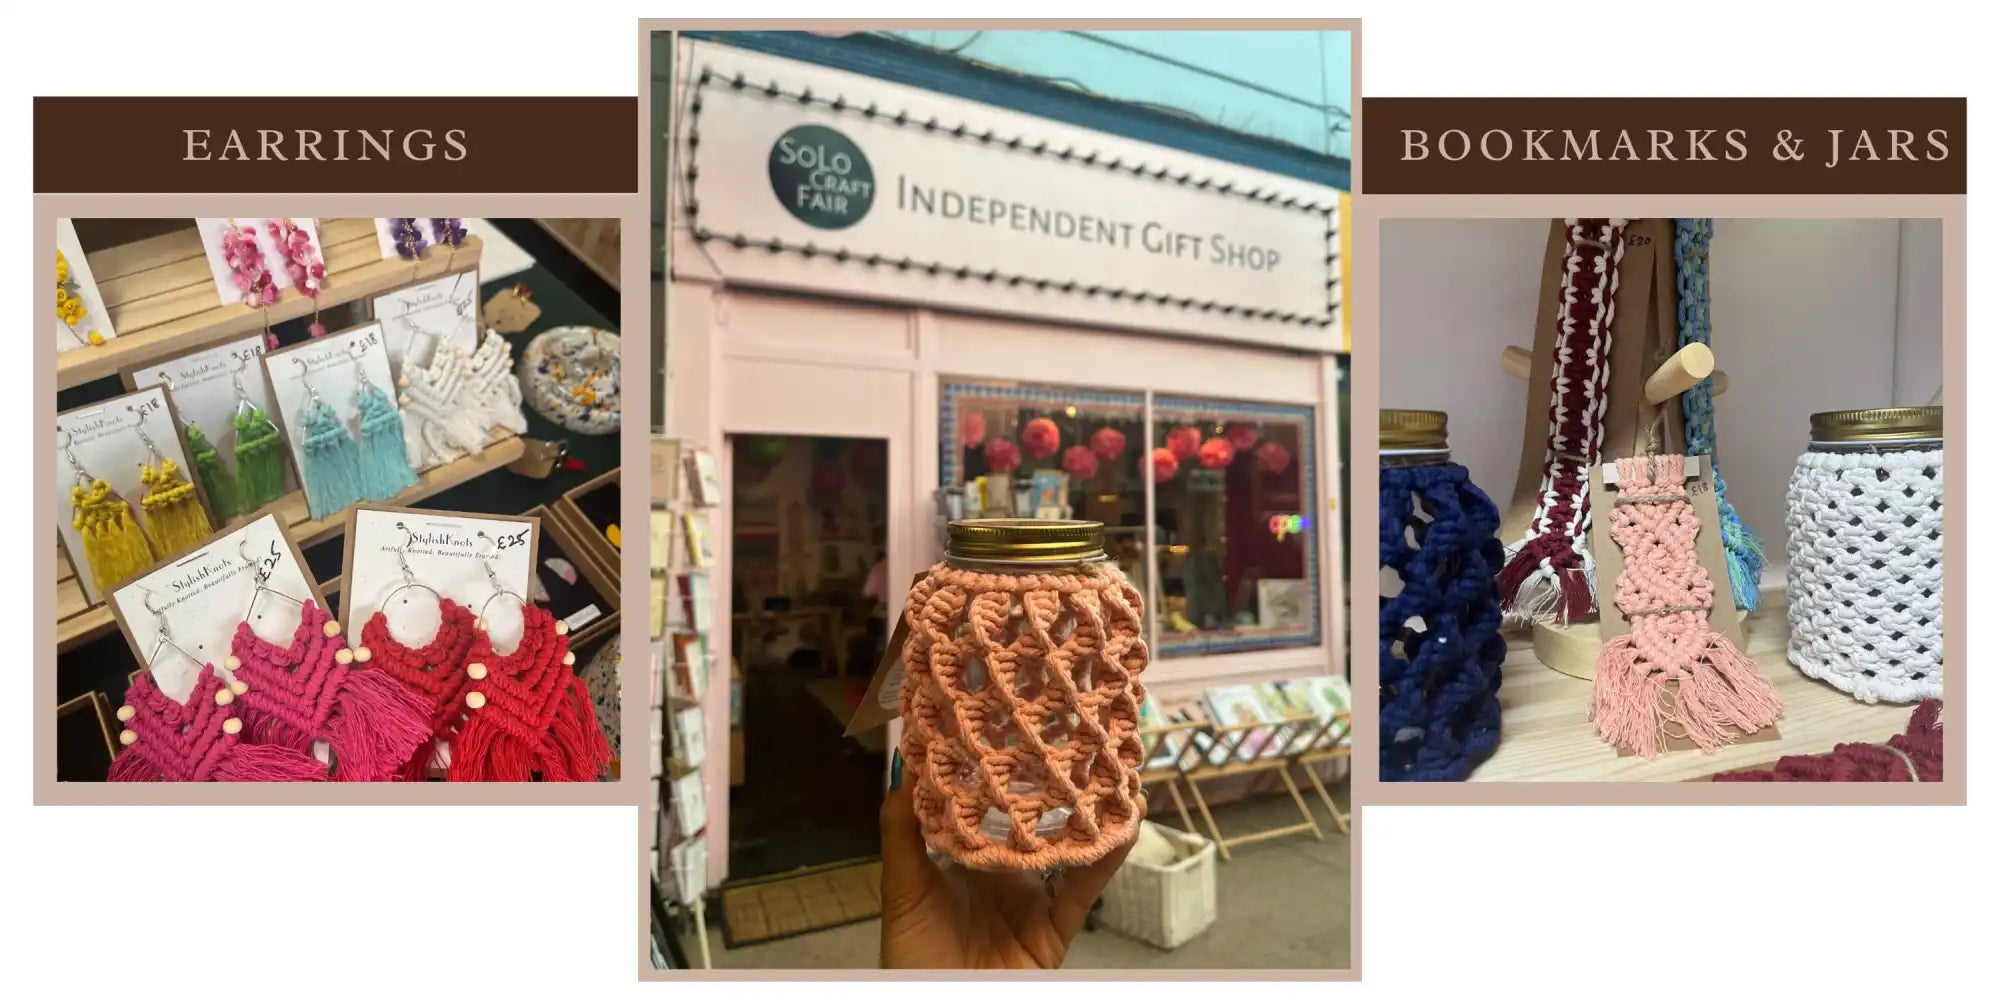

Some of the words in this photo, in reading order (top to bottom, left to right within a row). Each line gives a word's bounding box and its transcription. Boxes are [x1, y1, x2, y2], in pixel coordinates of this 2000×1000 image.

[809, 169, 872, 198] CRAFT
[797, 184, 849, 215] FAIR
[897, 174, 1135, 249] INDEPENDENT
[1141, 221, 1203, 261] GIFT
[1211, 233, 1282, 272] SHOP
[1627, 235, 1651, 247] £20
[243, 345, 262, 361] £18
[140, 398, 160, 416] £18
[411, 532, 473, 547] StylishKnots
[497, 528, 530, 550] £25
[259, 540, 281, 581] £25
[172, 559, 232, 593] StylishKnots
